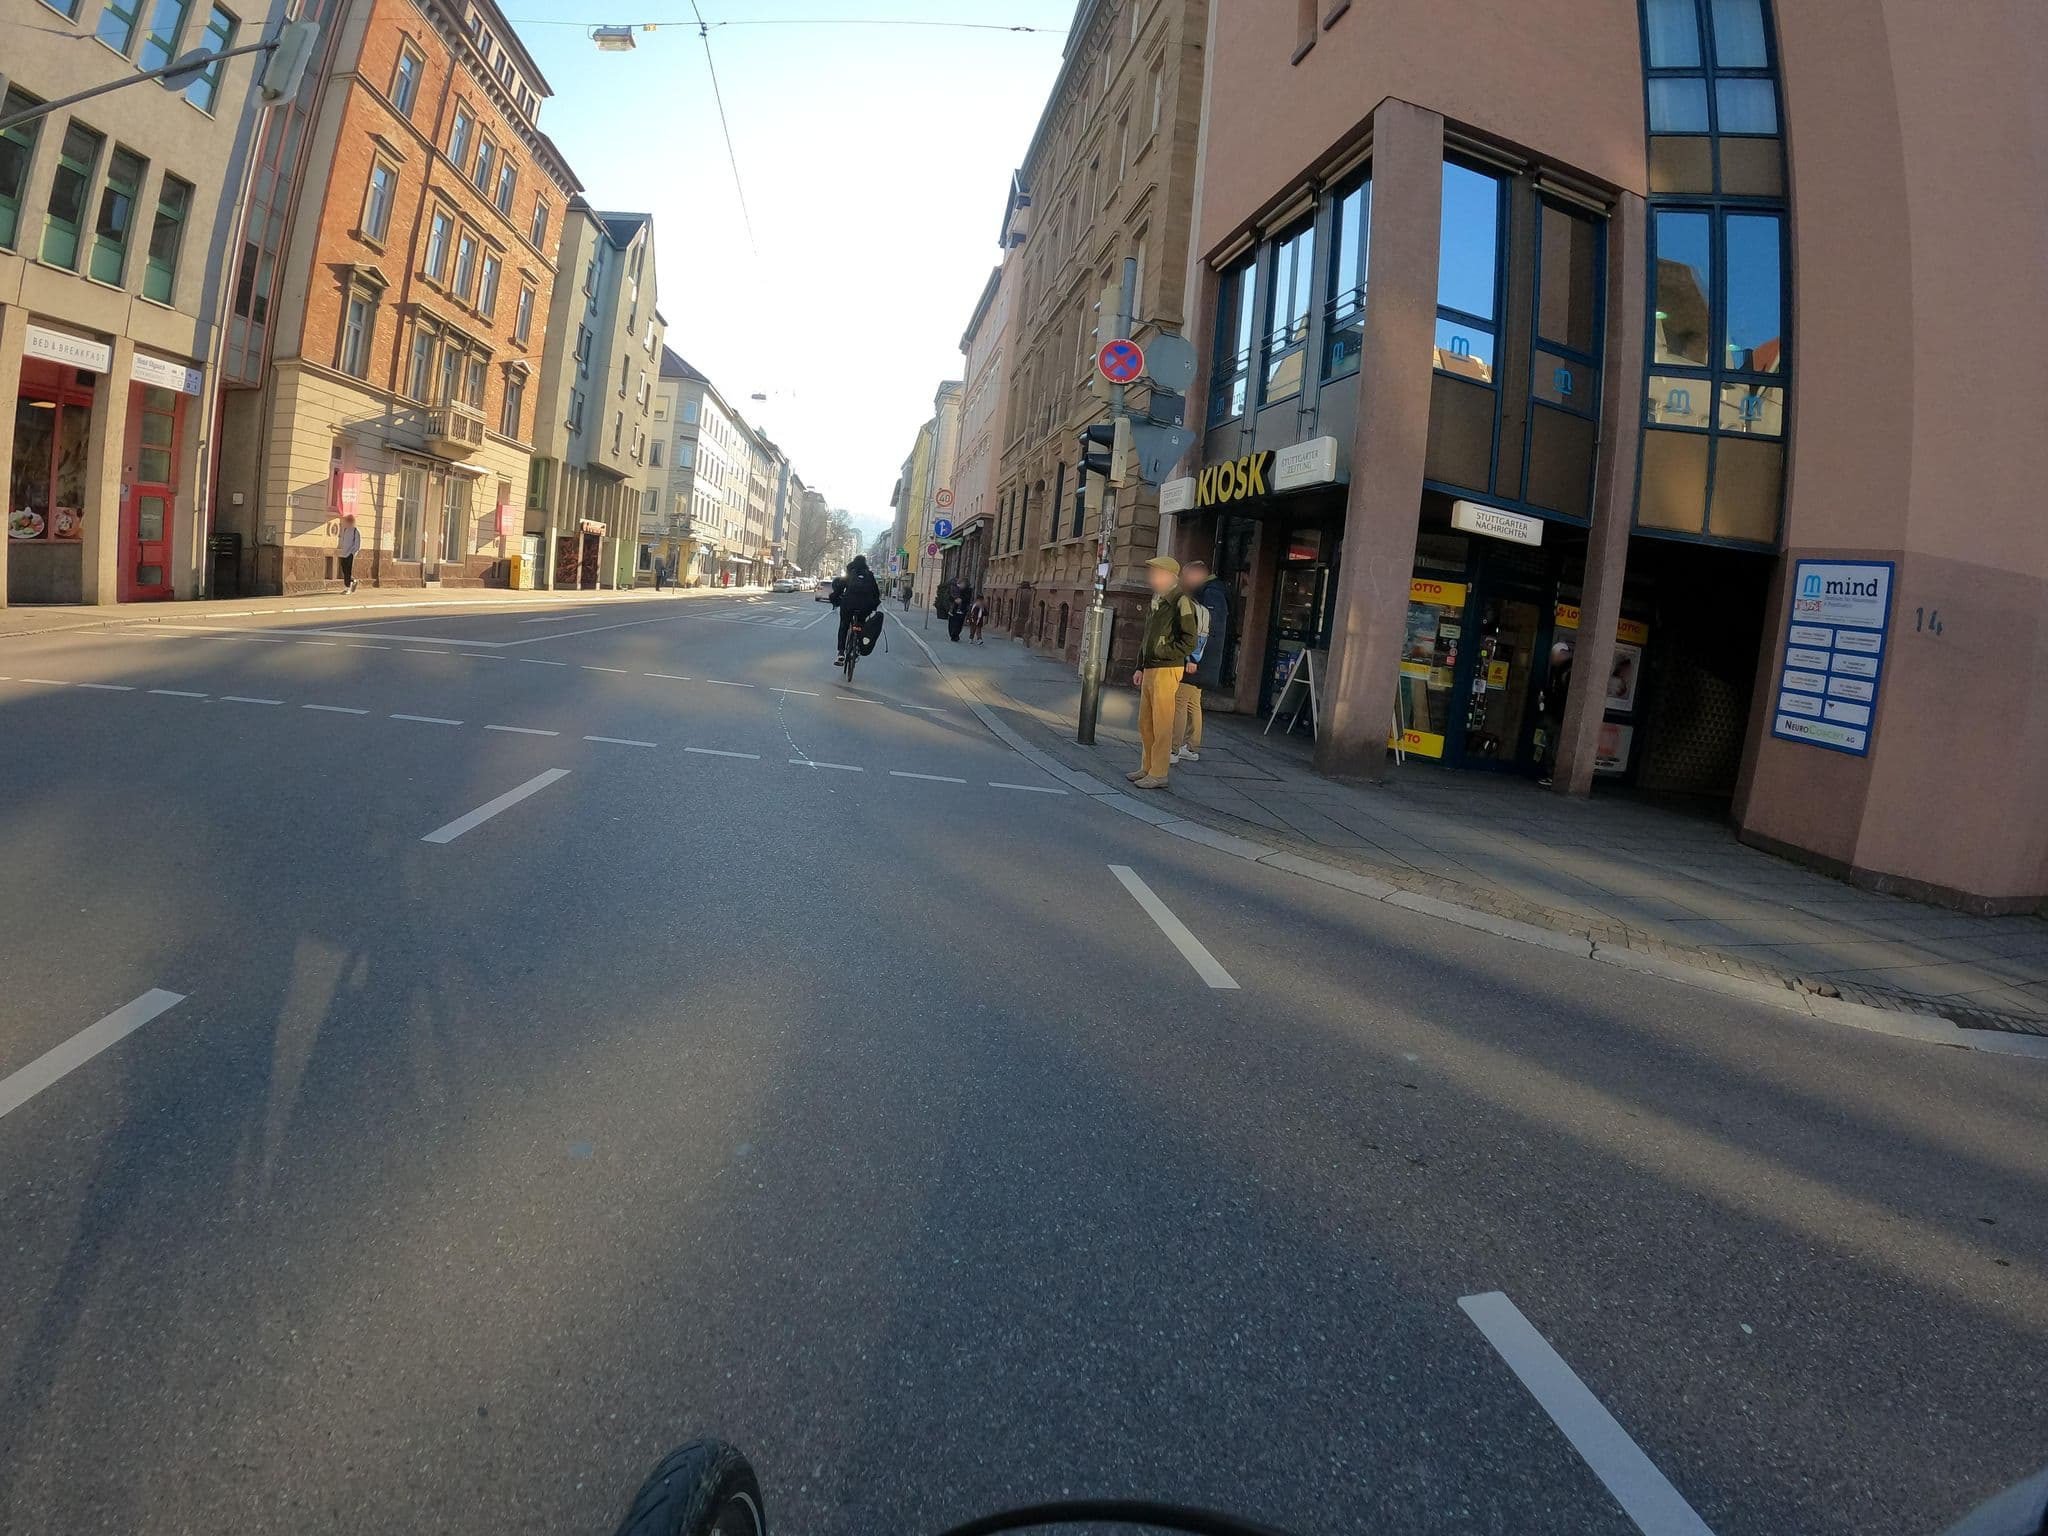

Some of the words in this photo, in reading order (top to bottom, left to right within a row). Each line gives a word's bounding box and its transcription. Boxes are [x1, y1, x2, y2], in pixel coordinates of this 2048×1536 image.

[32, 336, 49, 348] BED
[58, 343, 105, 362] BREAKFAST
[1197, 451, 1268, 507] KIOSK
[1475, 521, 1528, 539] NACHRICHTEN
[1476, 511, 1528, 531] STUTTGARTER
[1825, 577, 1878, 597] mind
[1567, 609, 1580, 619] LO
[1916, 607, 1943, 636] 14
